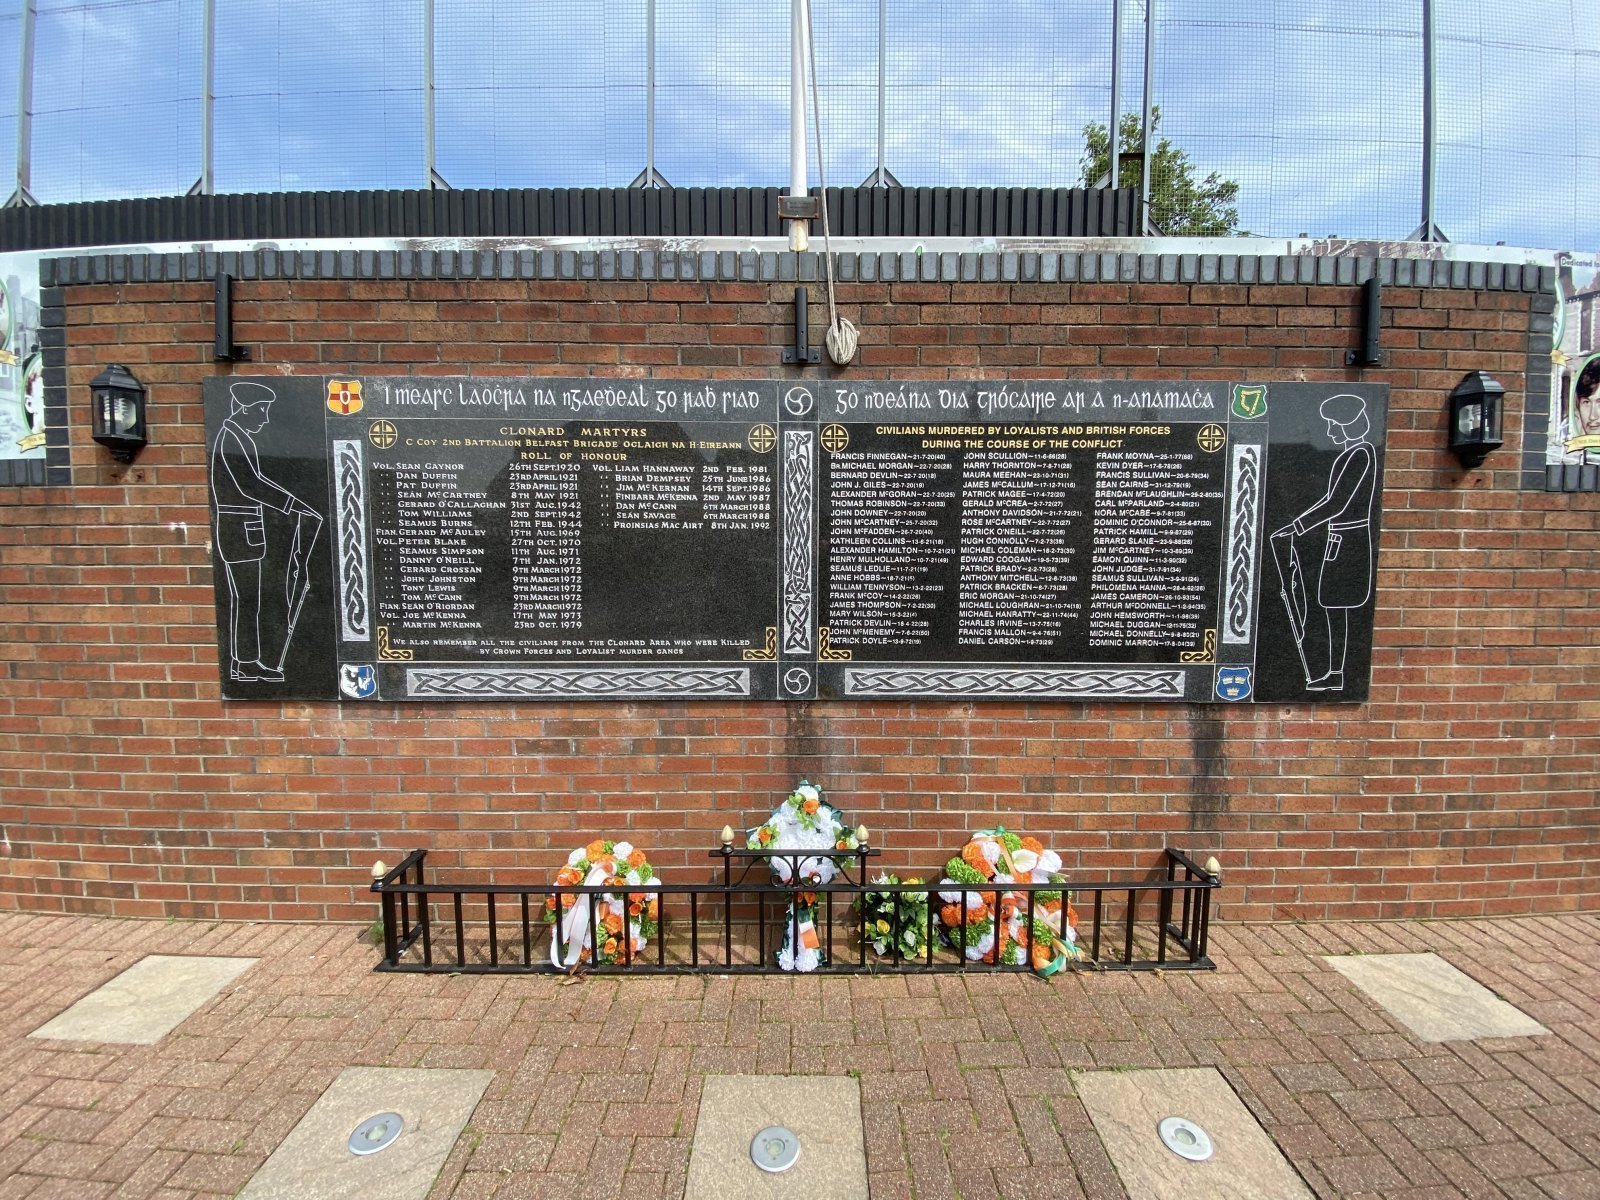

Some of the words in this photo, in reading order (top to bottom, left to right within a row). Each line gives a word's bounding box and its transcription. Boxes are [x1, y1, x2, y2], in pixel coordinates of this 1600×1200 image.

[500, 427, 564, 436] CLONARD
[581, 428, 646, 437] MARTYRS
[876, 426, 925, 435] CIVILIANS
[928, 426, 985, 435] MURDERED
[988, 426, 1001, 435] BY
[1004, 426, 1059, 435] LOYALISTS
[1061, 426, 1083, 434] AND
[1086, 426, 1126, 434] BRITISH
[1129, 426, 1170, 435] FORCES
[465, 438, 521, 447] BATTALION
[573, 440, 618, 448] BRIGADE
[922, 440, 961, 448] DURING
[964, 440, 984, 448] THE
[987, 440, 1029, 448] COURSE
[1032, 440, 1046, 448] OF
[1049, 440, 1069, 448] THE
[1072, 440, 1123, 448] CONFLICT
